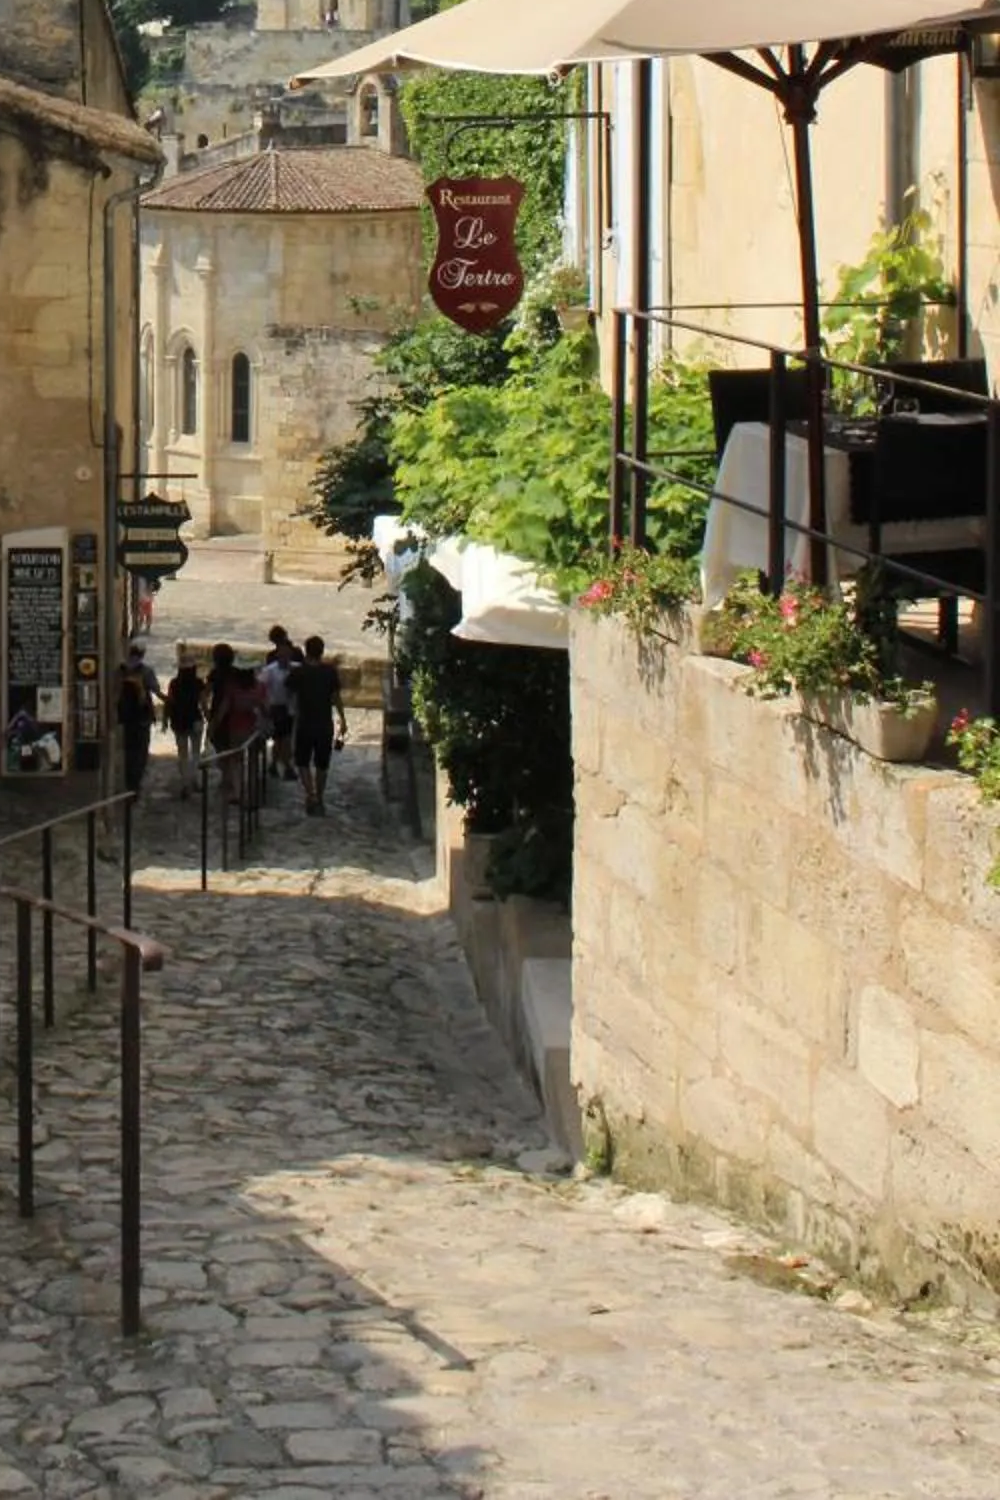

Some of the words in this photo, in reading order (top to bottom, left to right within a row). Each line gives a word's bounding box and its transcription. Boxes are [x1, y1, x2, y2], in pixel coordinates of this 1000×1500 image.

[440, 189, 512, 211] Restaurant
[454, 216, 497, 249] Le
[437, 257, 517, 290] Tertre
